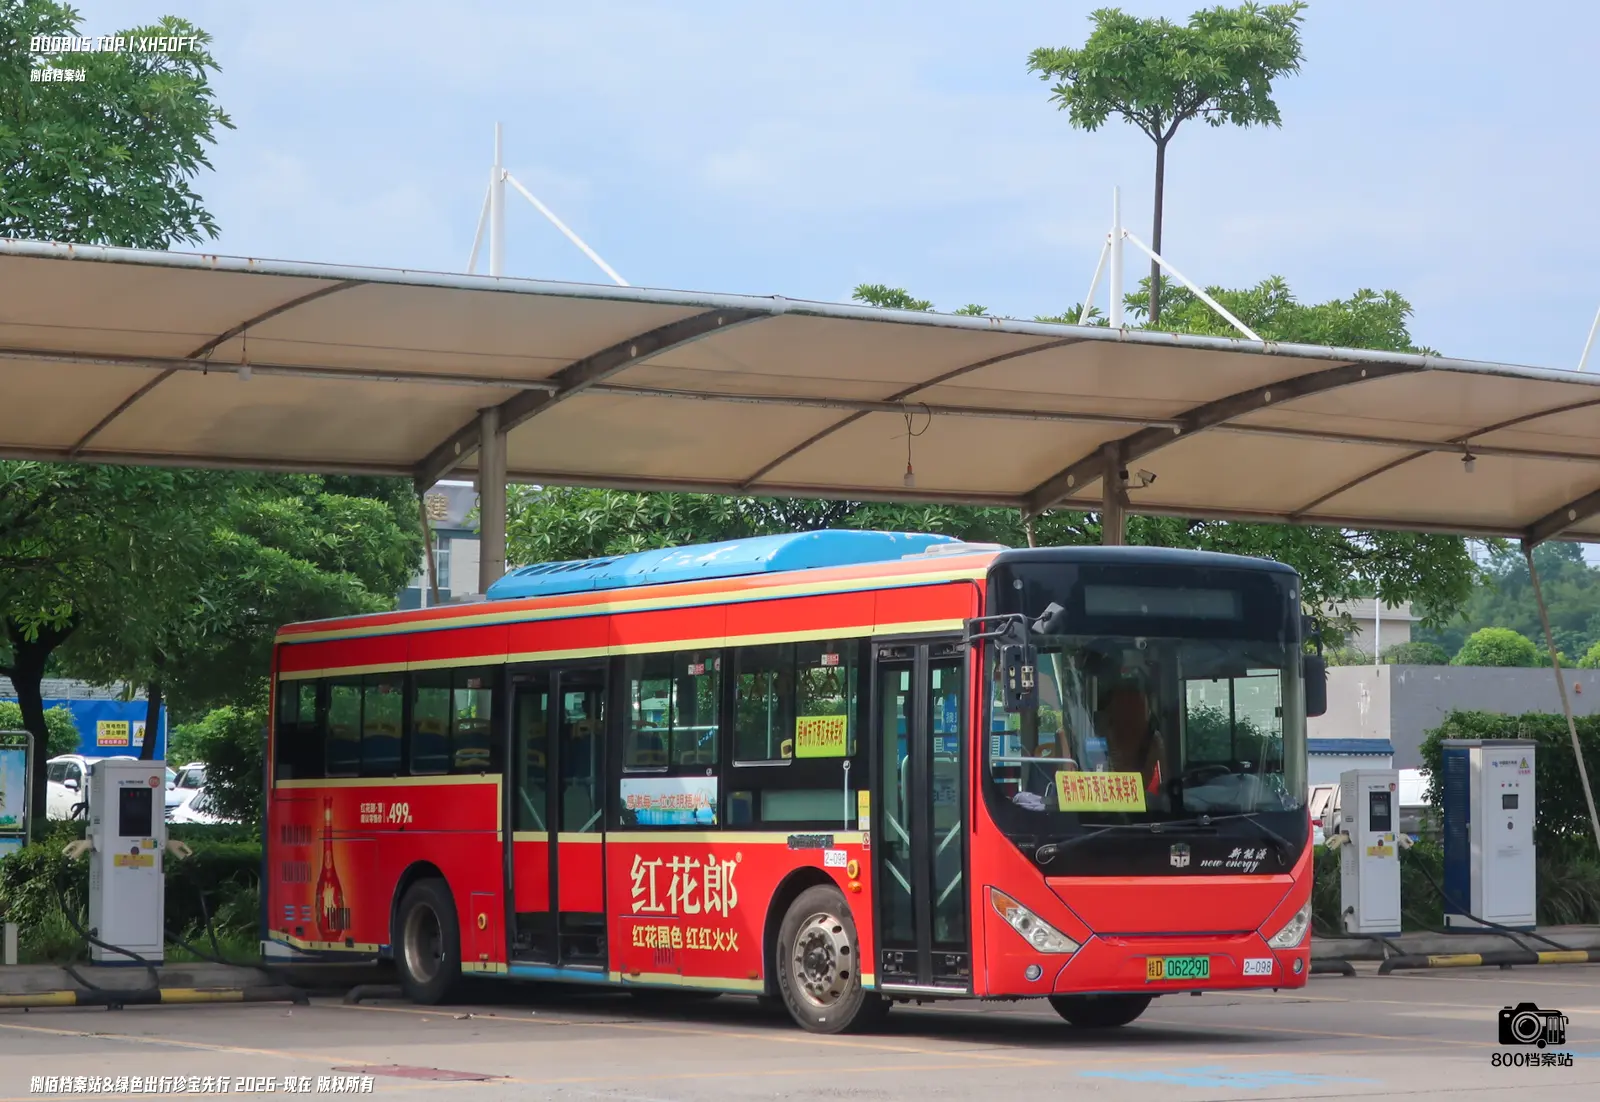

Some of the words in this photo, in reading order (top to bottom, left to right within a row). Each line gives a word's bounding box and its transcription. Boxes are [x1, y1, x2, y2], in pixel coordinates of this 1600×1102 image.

[825, 852, 846, 865] 2-098
[1228, 847, 1268, 860] 新能源
[1200, 859, 1223, 867] new
[1225, 859, 1260, 874] energy
[630, 853, 738, 918] 红花郎
[632, 924, 683, 949] 红花国色
[686, 926, 739, 952] 红红火火
[1167, 959, 1209, 977] 06229D
[1244, 960, 1272, 973] 2-098
